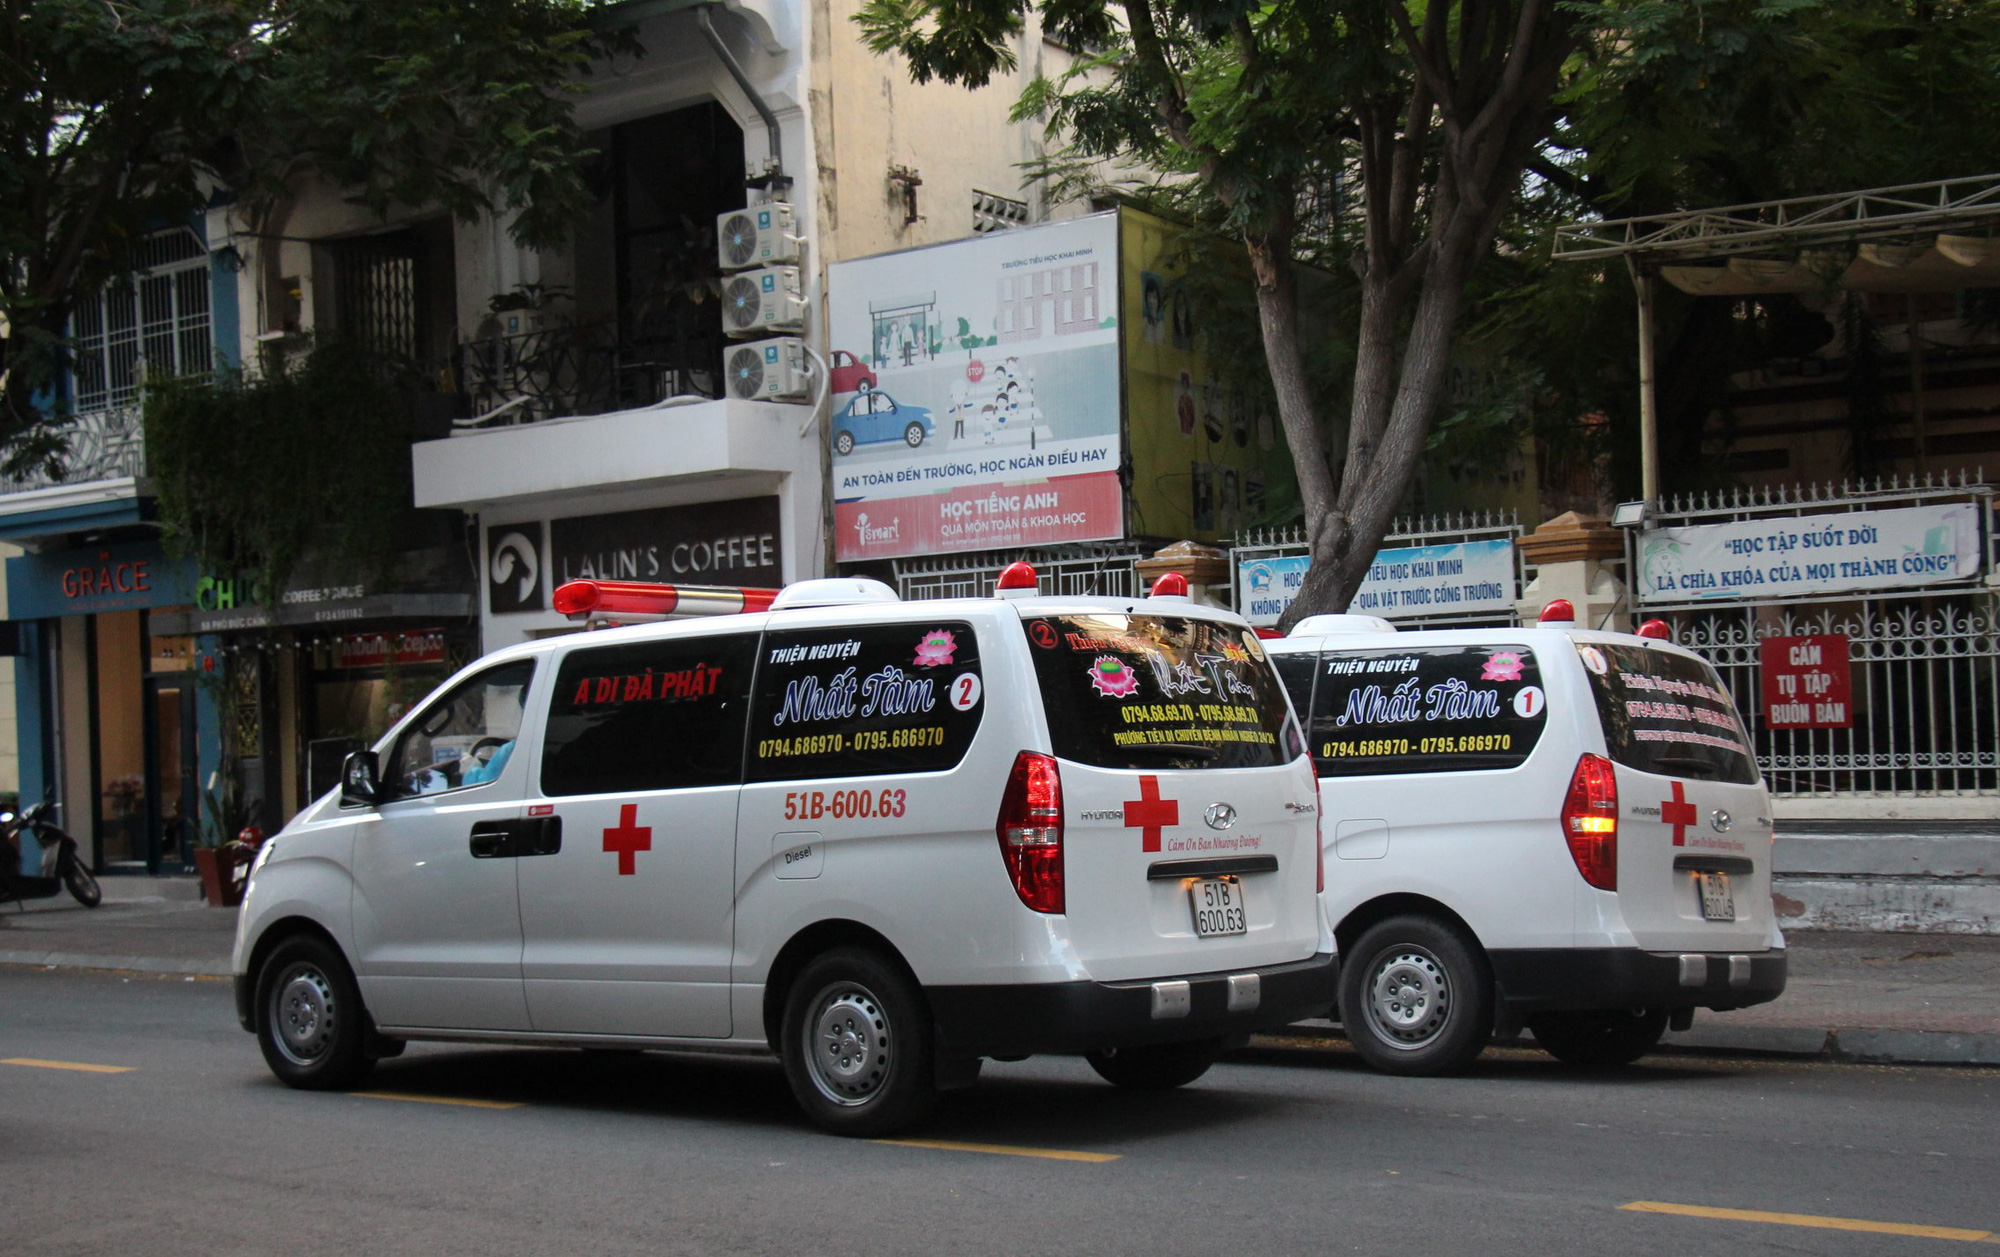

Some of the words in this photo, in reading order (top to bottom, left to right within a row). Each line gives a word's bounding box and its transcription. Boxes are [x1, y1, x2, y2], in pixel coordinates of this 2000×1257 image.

[1059, 251, 1075, 260] KHAI
[1076, 248, 1093, 257] MINH
[843, 476, 859, 488] AN
[862, 470, 894, 486] TOÀN
[896, 466, 921, 482] ĐẾN
[924, 462, 977, 479] TRƯỜNG,
[980, 460, 1006, 475] HỌC
[1009, 454, 1044, 470] NGÀN
[1048, 448, 1078, 466] ĐIỀU
[1081, 448, 1107, 462] HAY
[941, 501, 973, 522] HỌC
[975, 491, 1021, 514] TIẾNG
[1023, 492, 1058, 510] ANH
[941, 524, 963, 537] QUA
[965, 521, 989, 534] MÔN
[992, 517, 1020, 531] TOÁN
[1021, 517, 1029, 528] &
[1030, 515, 1061, 528] KHOA
[1063, 512, 1087, 527] HỌC
[1767, 531, 1798, 555] TẬP
[1802, 523, 1844, 549] SUỐT
[1848, 524, 1878, 545] ĐỜI
[563, 545, 660, 581] LALIN'S
[671, 534, 775, 574] COFFEE
[1390, 563, 1409, 582] HỌC
[1412, 561, 1434, 579] KHAI
[1437, 559, 1463, 575] MINH
[1284, 572, 1302, 590] HỌC
[1657, 571, 1676, 591] LÀ
[1680, 569, 1717, 589] CHÌA
[1721, 565, 1765, 587] KHÓA
[1771, 560, 1802, 582] CỦA
[1806, 563, 1836, 584] MỌI
[1839, 557, 1898, 578] THÀNH
[282, 587, 321, 604] COFFEE
[1251, 597, 1281, 616] KHÔNG
[1360, 589, 1379, 611] QUÀ
[1400, 585, 1431, 606] TRƯỚC
[1434, 581, 1461, 604] CỔNG
[1463, 580, 1503, 600] TRƯỜNG
[1037, 625, 1053, 645] 2
[769, 644, 807, 666] THIỆN
[808, 639, 861, 661] NGUYỆN
[1327, 658, 1364, 676] THIỆN
[1366, 656, 1420, 675] NGUYỆN
[1790, 639, 1822, 666] CẤM
[574, 678, 591, 704] A
[594, 676, 620, 703] DI
[623, 667, 653, 701] ĐÀ
[660, 662, 722, 702] PHẬT
[774, 666, 858, 727] Nhất
[861, 664, 936, 717] Tâm
[959, 678, 972, 706] 2
[1776, 675, 1796, 698] TỤ
[1802, 669, 1831, 698] TẬP
[1121, 704, 1193, 724] 0794.68.69.70
[1200, 704, 1258, 724] 0795.68.69.70
[1336, 677, 1422, 727] Nhất
[1425, 677, 1501, 721] Tâm
[1523, 691, 1533, 713] 1
[1771, 699, 1811, 724] BUÔN
[1815, 697, 1846, 723] BÁN
[759, 733, 842, 758] 0794.686970
[854, 726, 944, 751] 0795.686970
[1146, 727, 1166, 745] TIỆN
[1165, 729, 1175, 742] DI
[1174, 723, 1203, 742] CHUYỂN
[1322, 738, 1408, 758] 0794.686970
[1420, 734, 1511, 754] 0795.686970
[784, 789, 907, 820] 51B-600.63
[1081, 809, 1124, 820] HYUNDAI
[785, 846, 812, 864] Diesel
[1198, 837, 1212, 853] Bạn
[1205, 883, 1230, 907] 51B
[1199, 907, 1244, 934] 600.63
